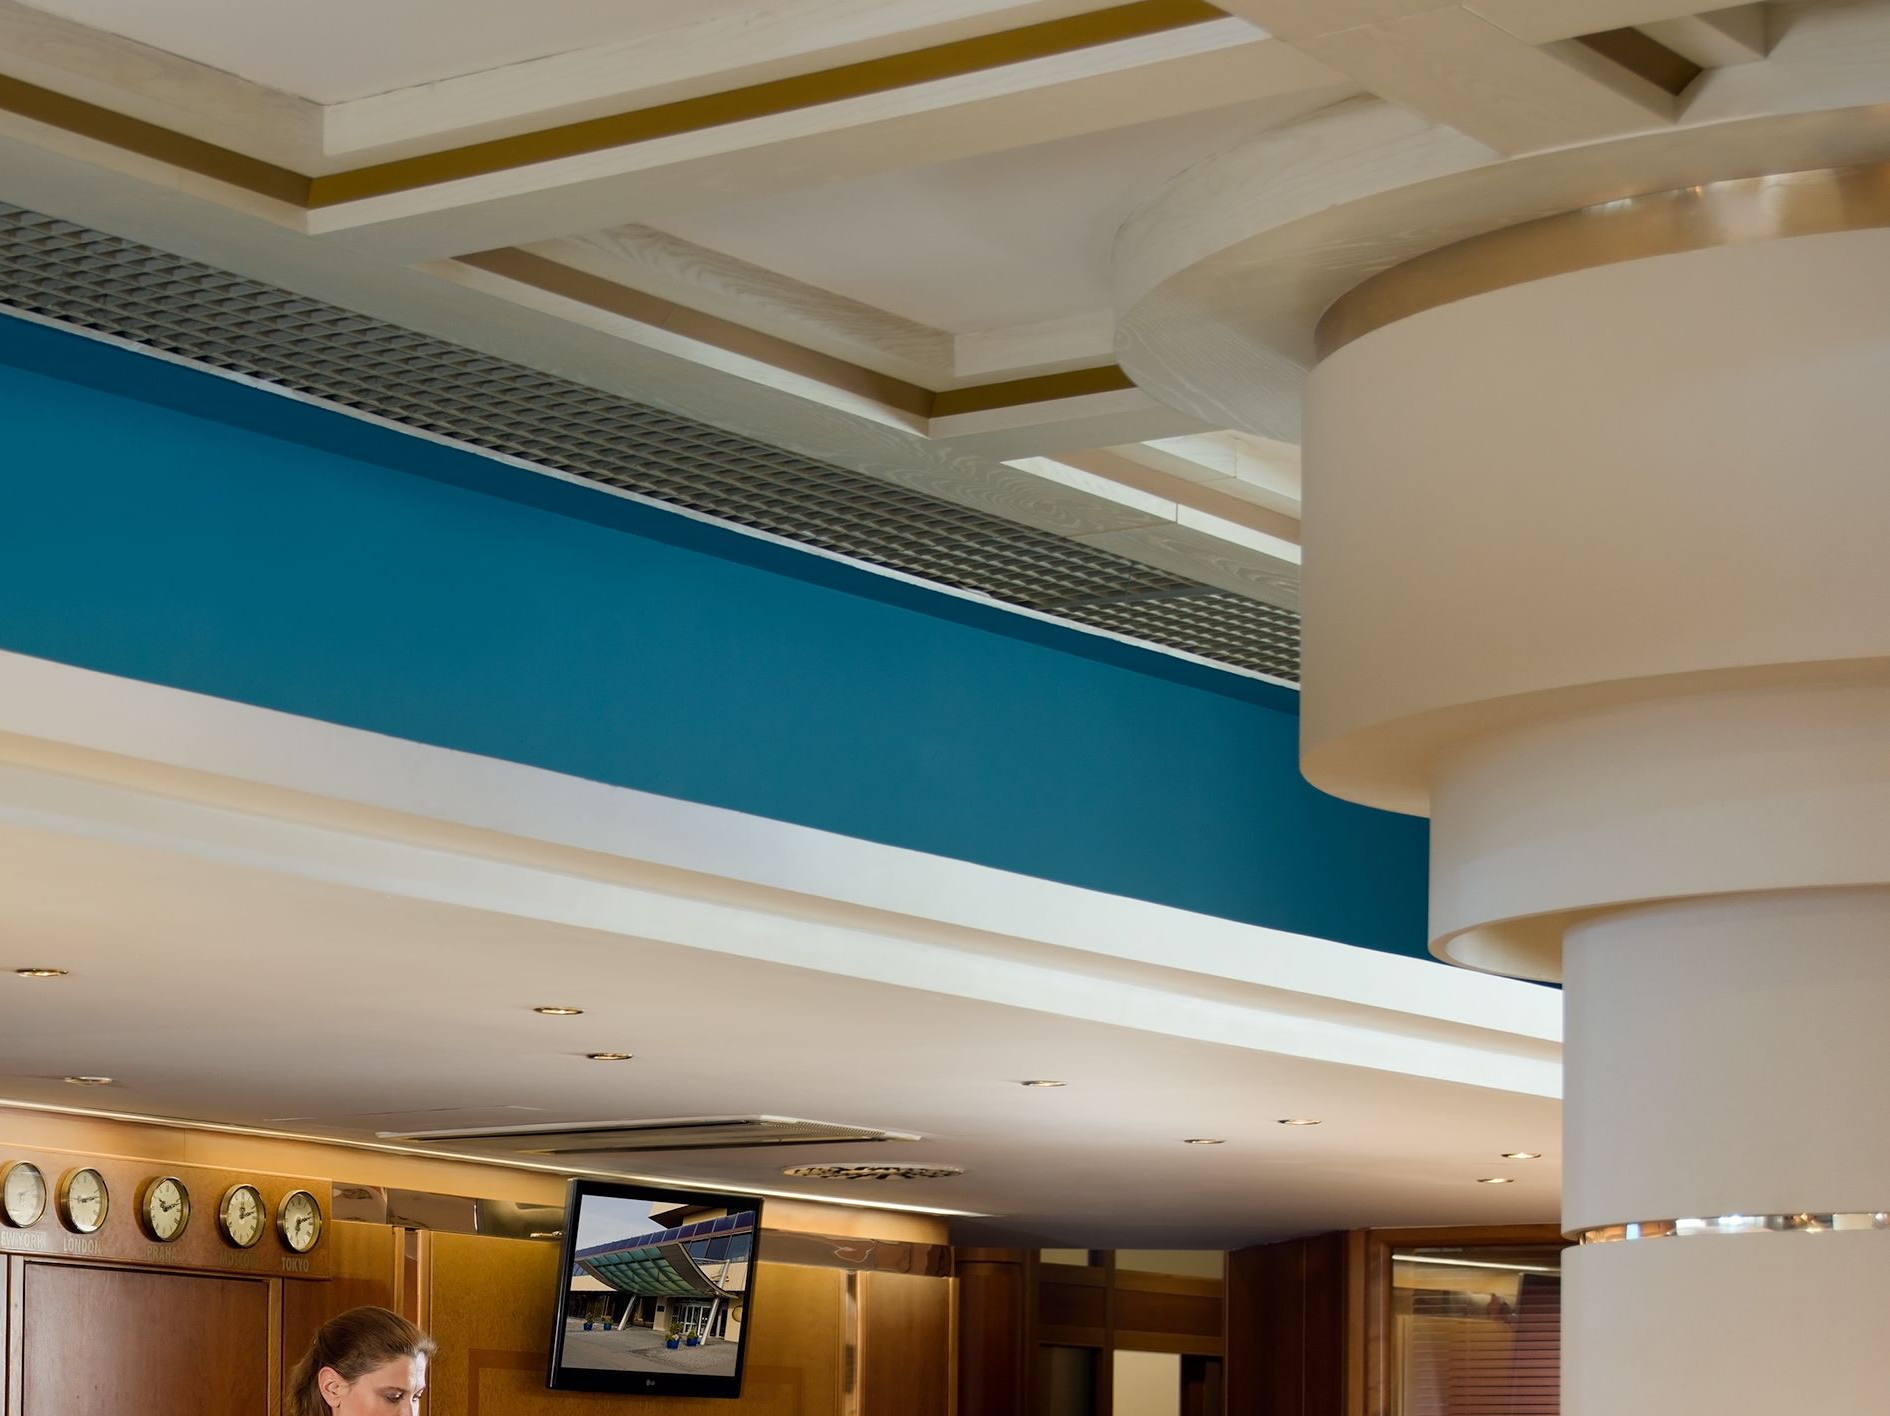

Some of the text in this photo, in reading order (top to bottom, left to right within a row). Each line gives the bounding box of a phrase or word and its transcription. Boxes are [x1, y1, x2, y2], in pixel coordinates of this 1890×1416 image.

[17, 1231, 45, 1249] YORK
[63, 1236, 102, 1255] LONDON
[147, 1244, 178, 1264] PRAHA
[281, 1256, 309, 1273] TOKYO
